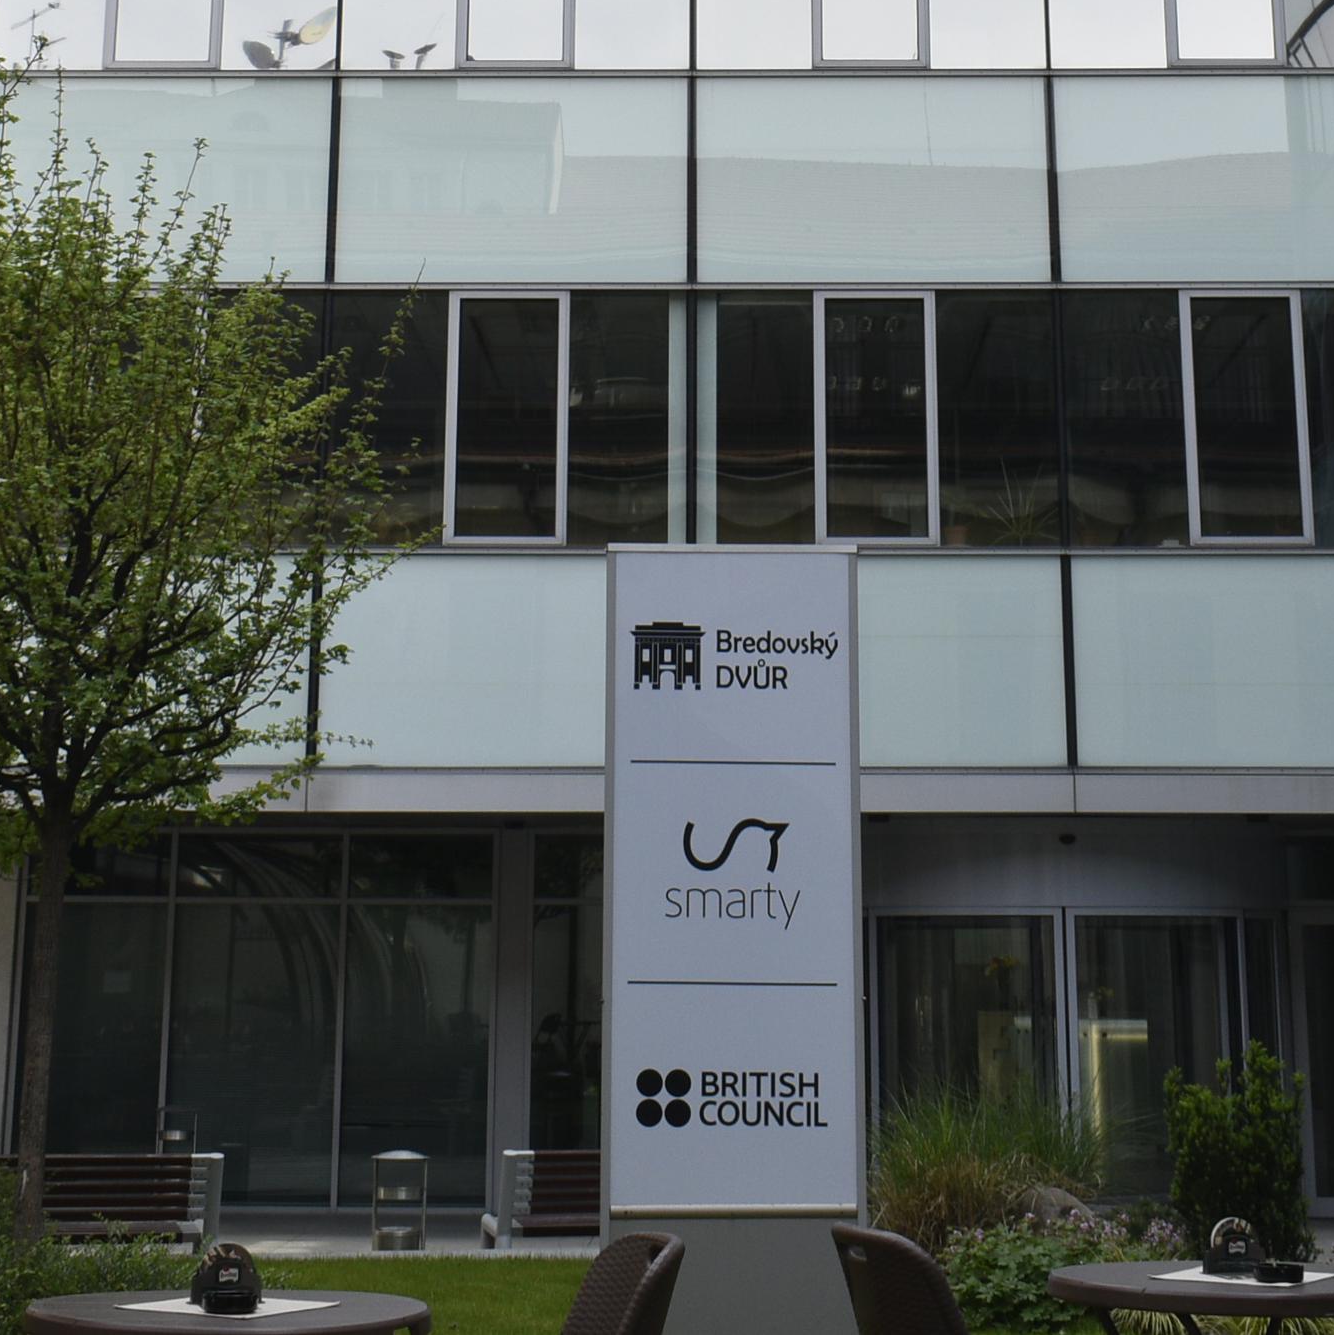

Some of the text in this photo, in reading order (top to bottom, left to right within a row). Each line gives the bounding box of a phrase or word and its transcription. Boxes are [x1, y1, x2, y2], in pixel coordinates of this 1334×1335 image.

[716, 629, 839, 660] Bredovský
[716, 658, 788, 690] DVŮR
[665, 883, 801, 931] smarty
[701, 1071, 819, 1098] BRITISH
[699, 1100, 828, 1128] COUNCIL
